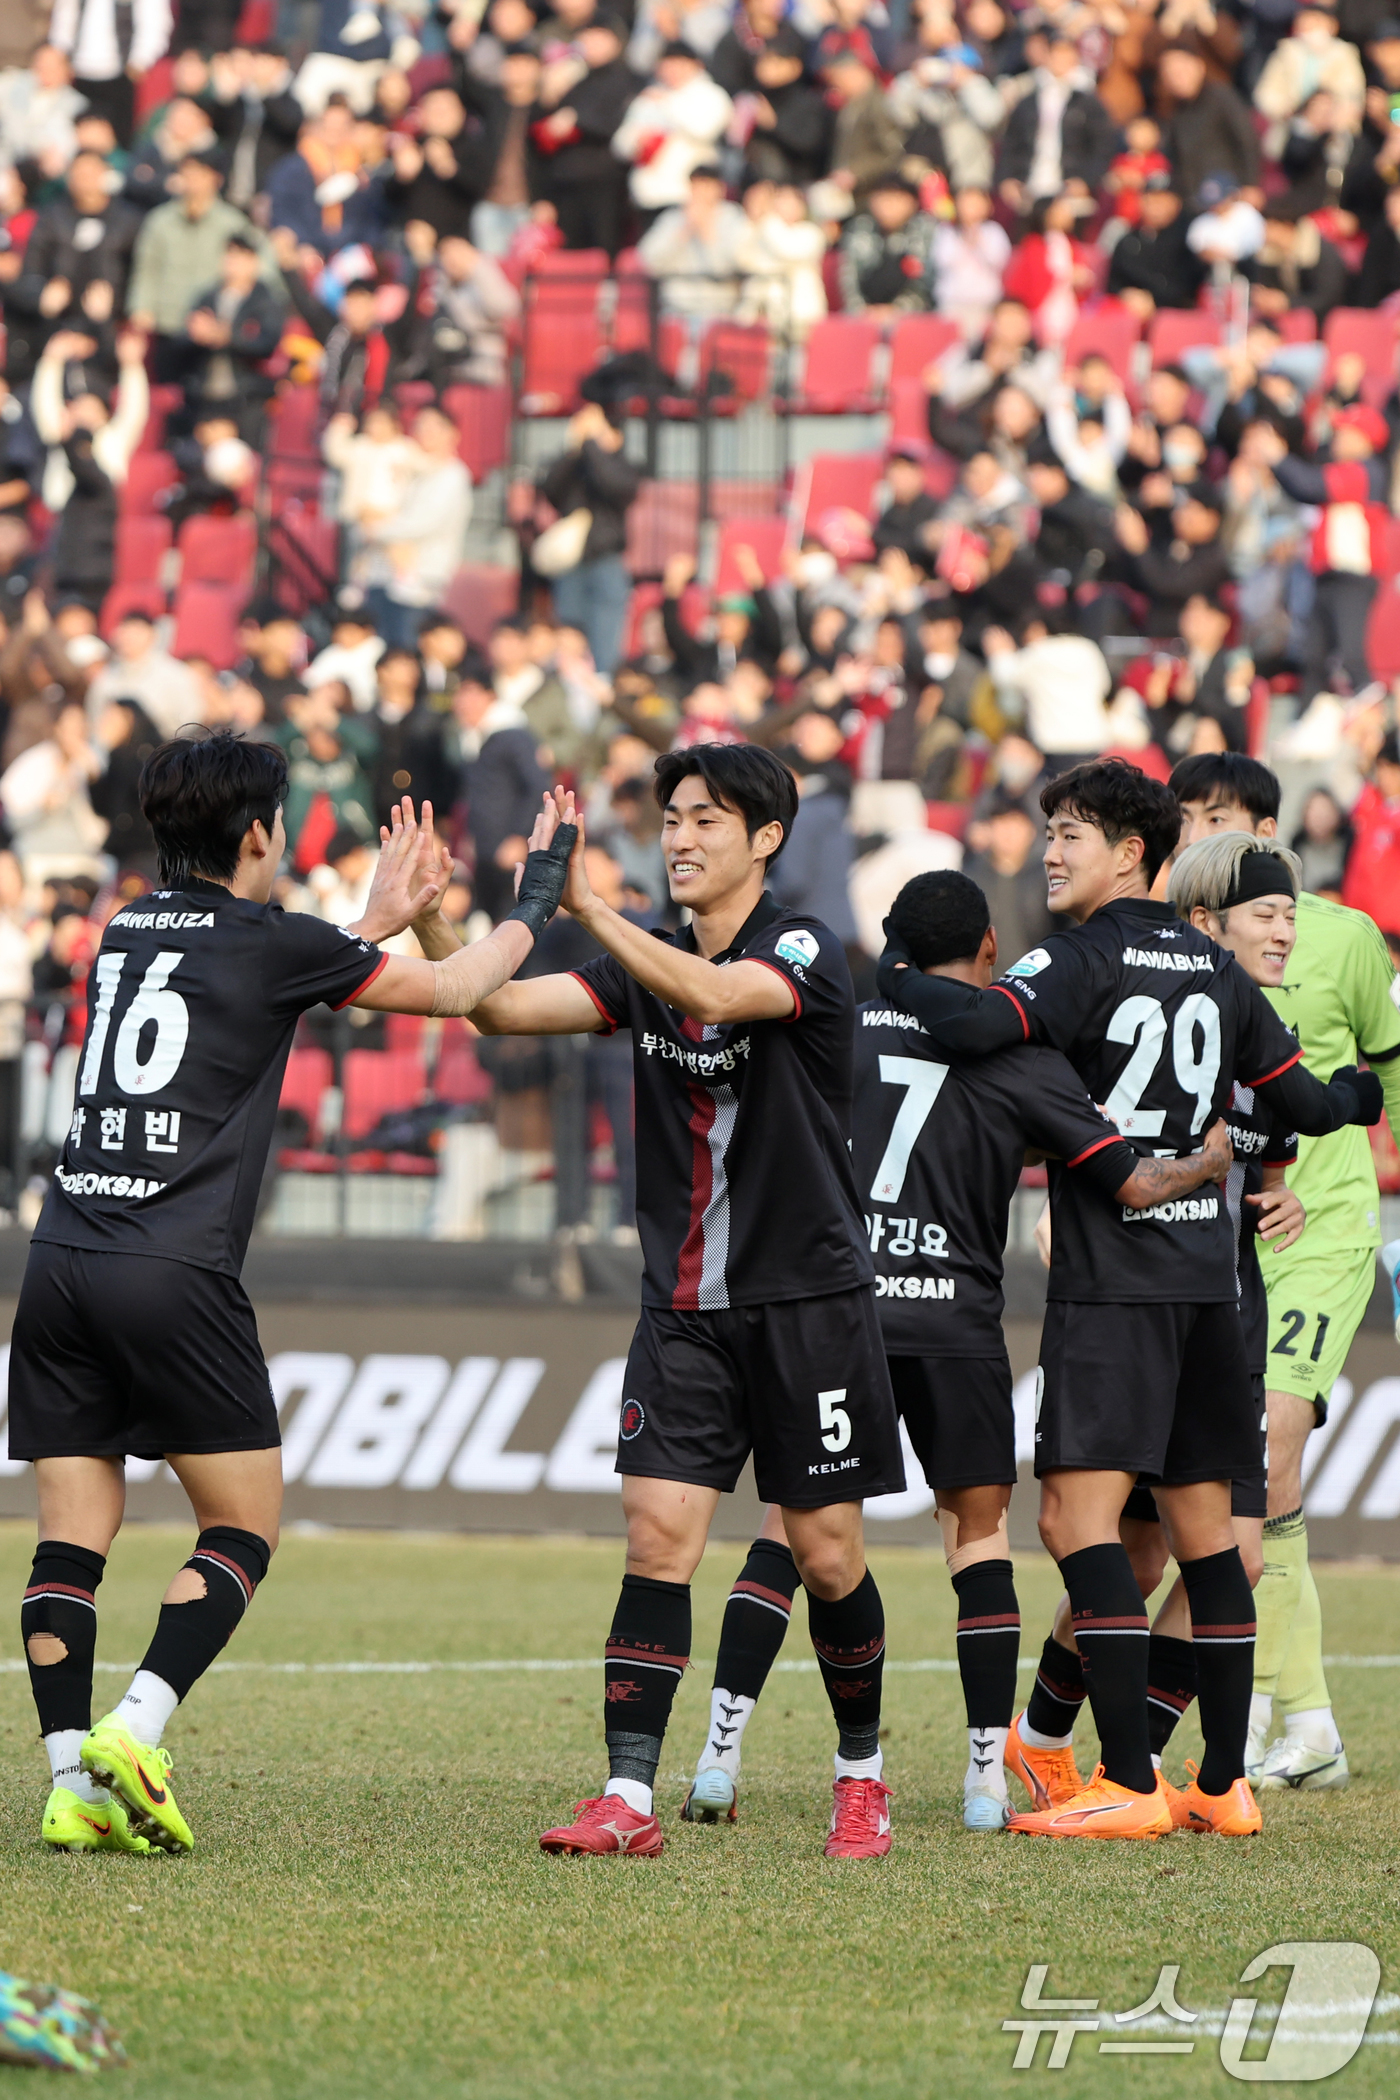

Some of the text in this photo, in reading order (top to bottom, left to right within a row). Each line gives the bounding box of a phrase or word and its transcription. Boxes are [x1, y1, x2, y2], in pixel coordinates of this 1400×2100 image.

[1122, 946, 1215, 973] WAWABUZA
[1014, 978, 1038, 1001] ENG
[79, 951, 190, 1096] 16
[862, 1010, 931, 1036] WAWA
[1105, 992, 1222, 1138] 29
[869, 1054, 951, 1204] 7
[1270, 1308, 1331, 1363] 21
[817, 1387, 853, 1453] 5
[808, 1457, 861, 1476] KELME
